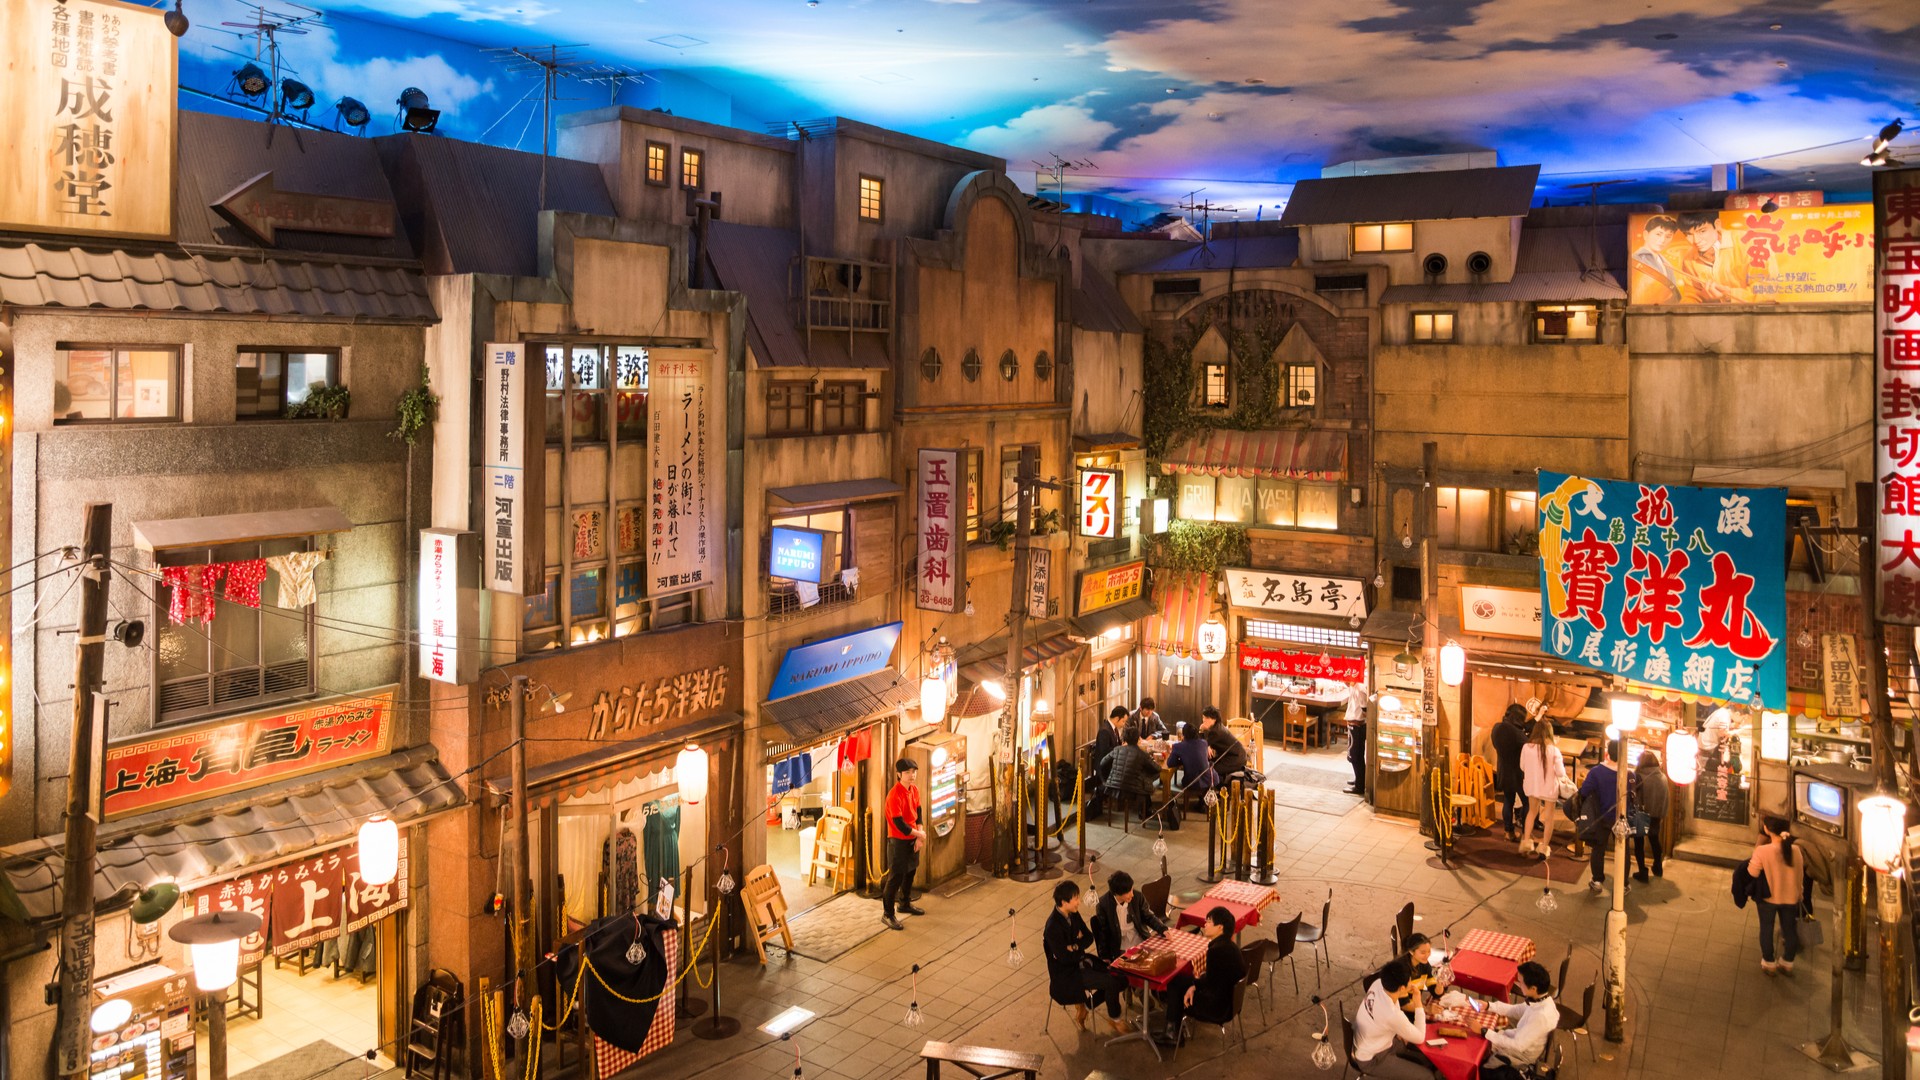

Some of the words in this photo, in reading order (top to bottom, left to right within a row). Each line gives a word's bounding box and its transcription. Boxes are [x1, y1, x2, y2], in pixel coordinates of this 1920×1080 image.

[494, 351, 516, 367] 三階
[658, 363, 699, 376] 新刊本
[500, 369, 511, 462] 野村法律事務所
[494, 474, 515, 491] 二階
[1086, 473, 1111, 535] クスリ
[1574, 484, 1607, 521] 大
[1716, 493, 1754, 538] 漁
[1632, 484, 1674, 528] 祝
[494, 496, 514, 584] 河童出版
[922, 459, 951, 587] 玉置歯科
[1608, 516, 1714, 555] 第五十八
[778, 546, 815, 561] NARUMI
[778, 556, 815, 570] IPPUDO
[657, 568, 703, 589] 河童出版
[1262, 577, 1348, 611] 名島亭
[789, 662, 839, 684] NARUMI
[841, 650, 883, 670] IPPUDO
[1830, 661, 1854, 707] 田辺書店
[587, 665, 729, 741] からたち洋装店
[316, 729, 371, 754] ラーメン
